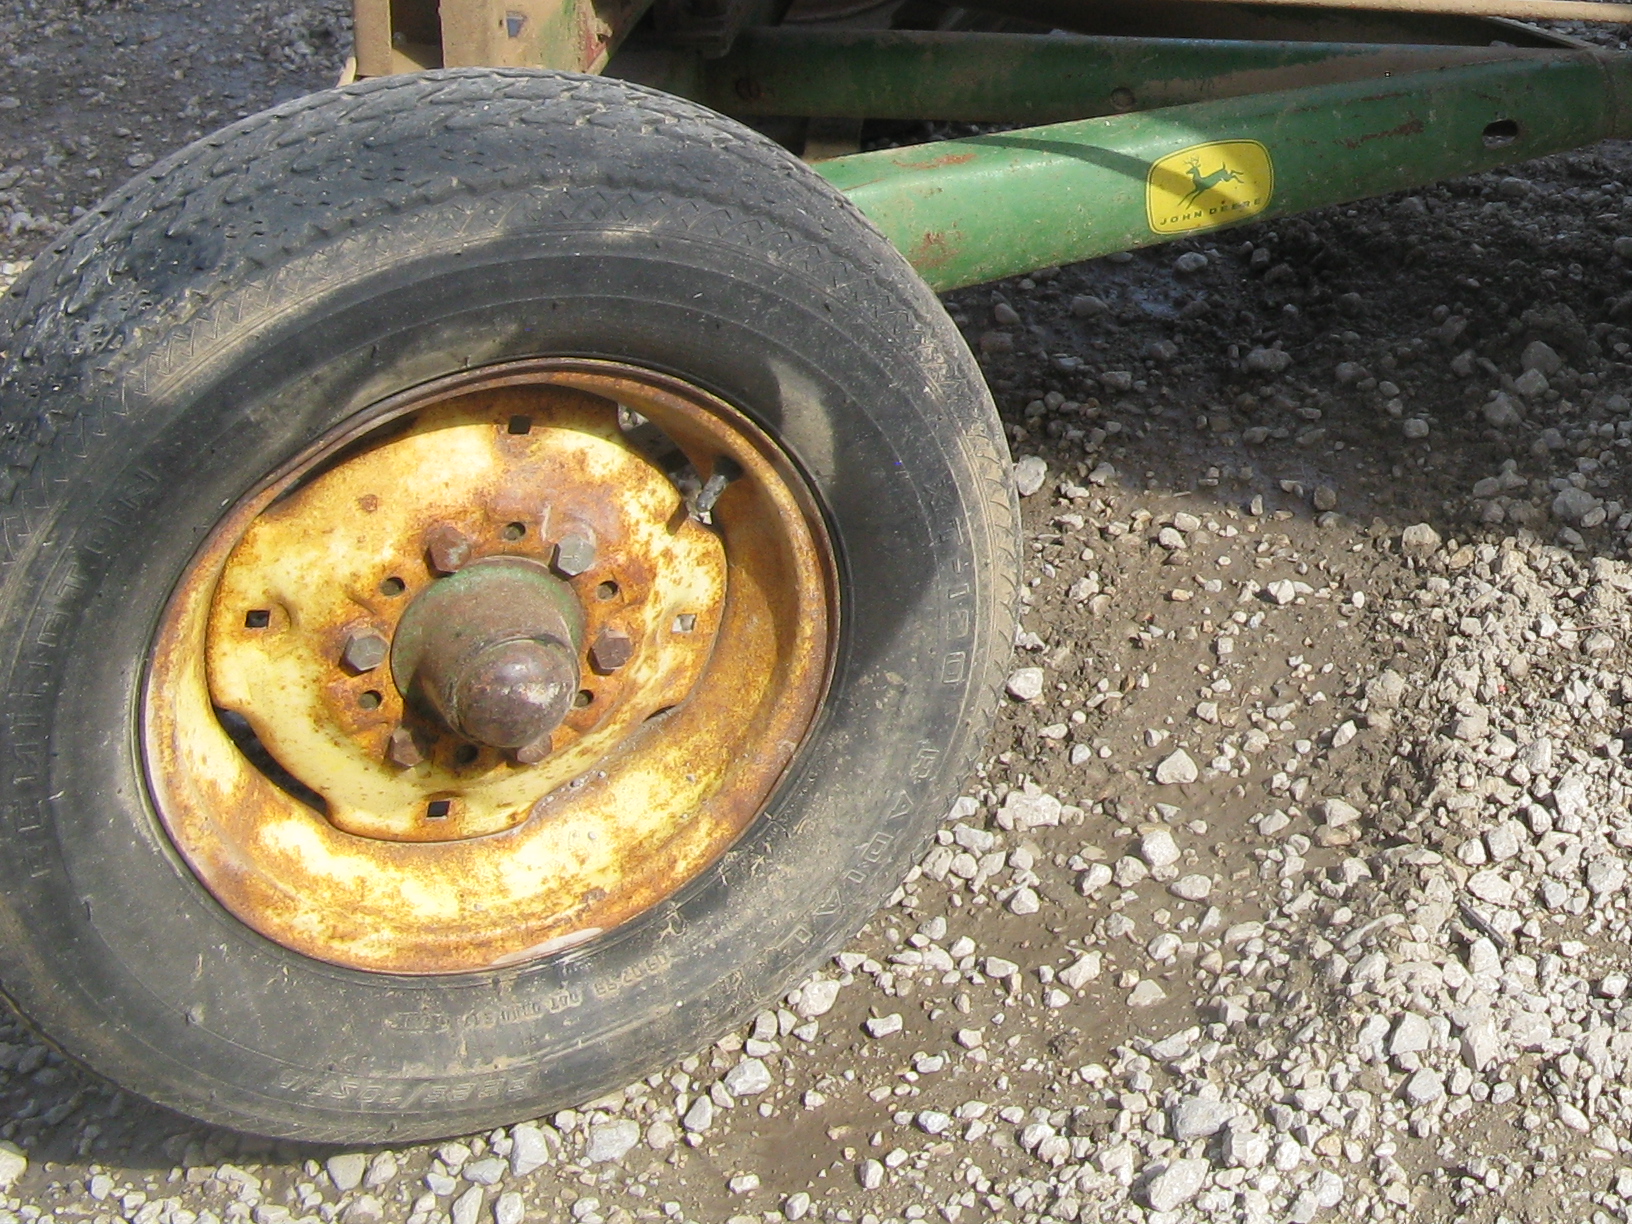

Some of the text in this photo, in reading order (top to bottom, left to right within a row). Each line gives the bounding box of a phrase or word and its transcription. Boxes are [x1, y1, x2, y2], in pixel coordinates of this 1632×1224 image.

[1160, 197, 1262, 225] JOHN DEERE
[772, 743, 941, 952] RADIAL
